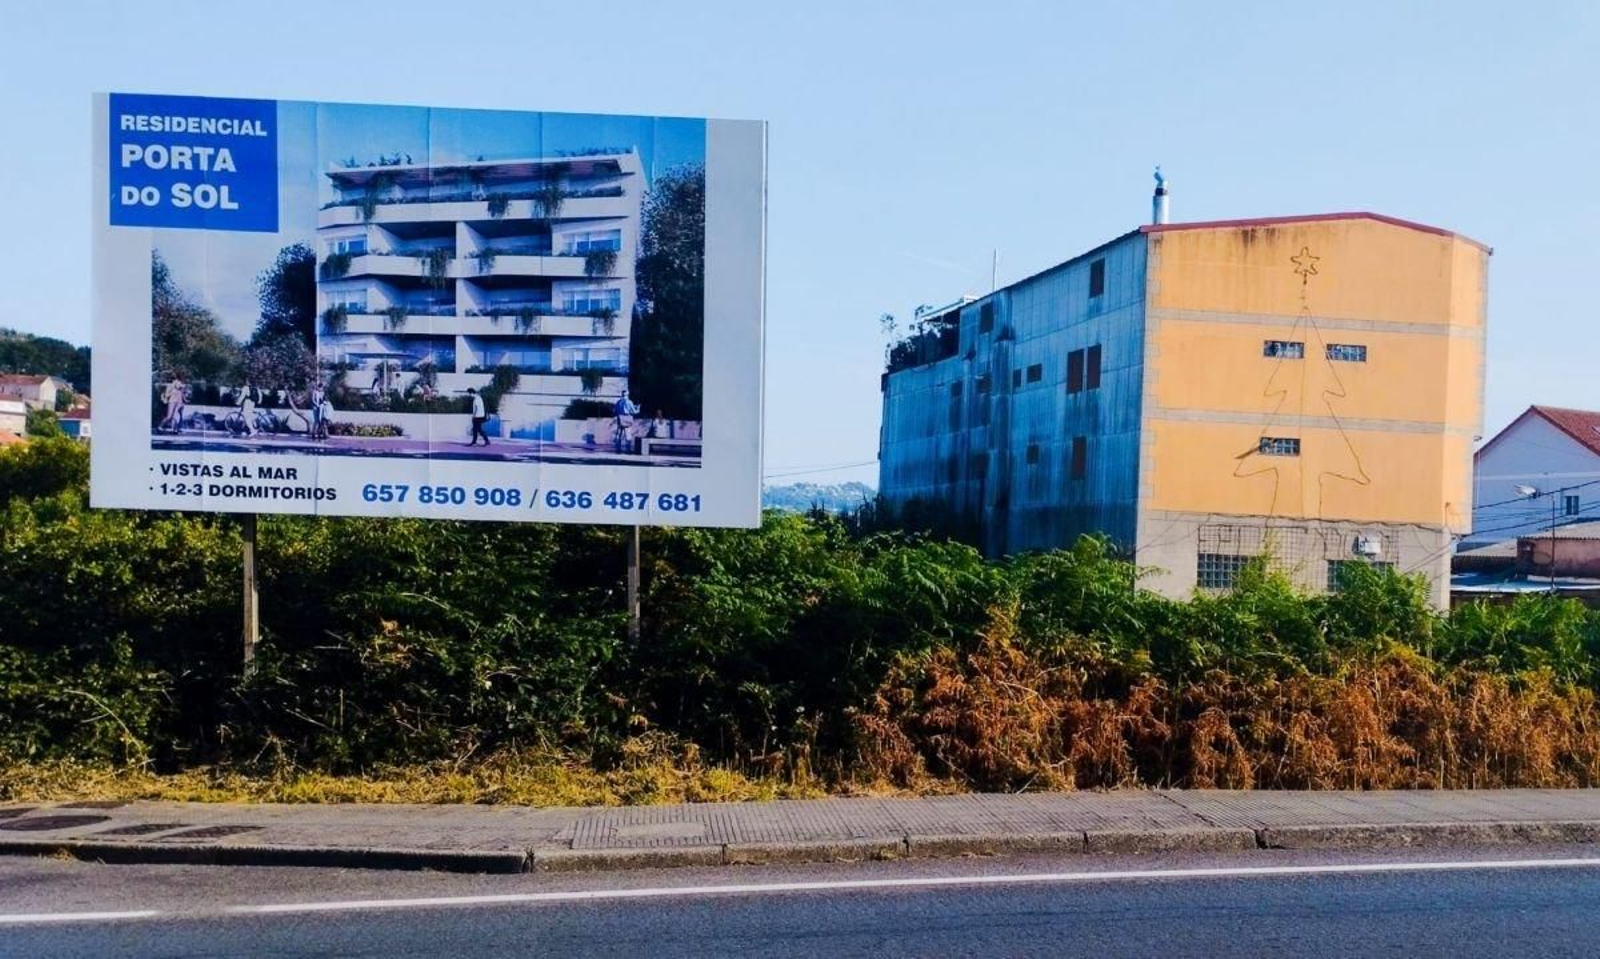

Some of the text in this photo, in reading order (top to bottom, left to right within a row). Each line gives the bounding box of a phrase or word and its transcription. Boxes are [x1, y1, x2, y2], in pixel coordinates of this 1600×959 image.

[120, 114, 268, 136] RESIDENCIAL
[121, 144, 237, 172] PORTA
[121, 182, 239, 210] DO SOL
[160, 463, 298, 480] VISTAS AL MAR
[160, 483, 337, 501] 1-2-3 DORMITORIOS
[362, 483, 702, 512] 657 850 908 / 636 487 681
